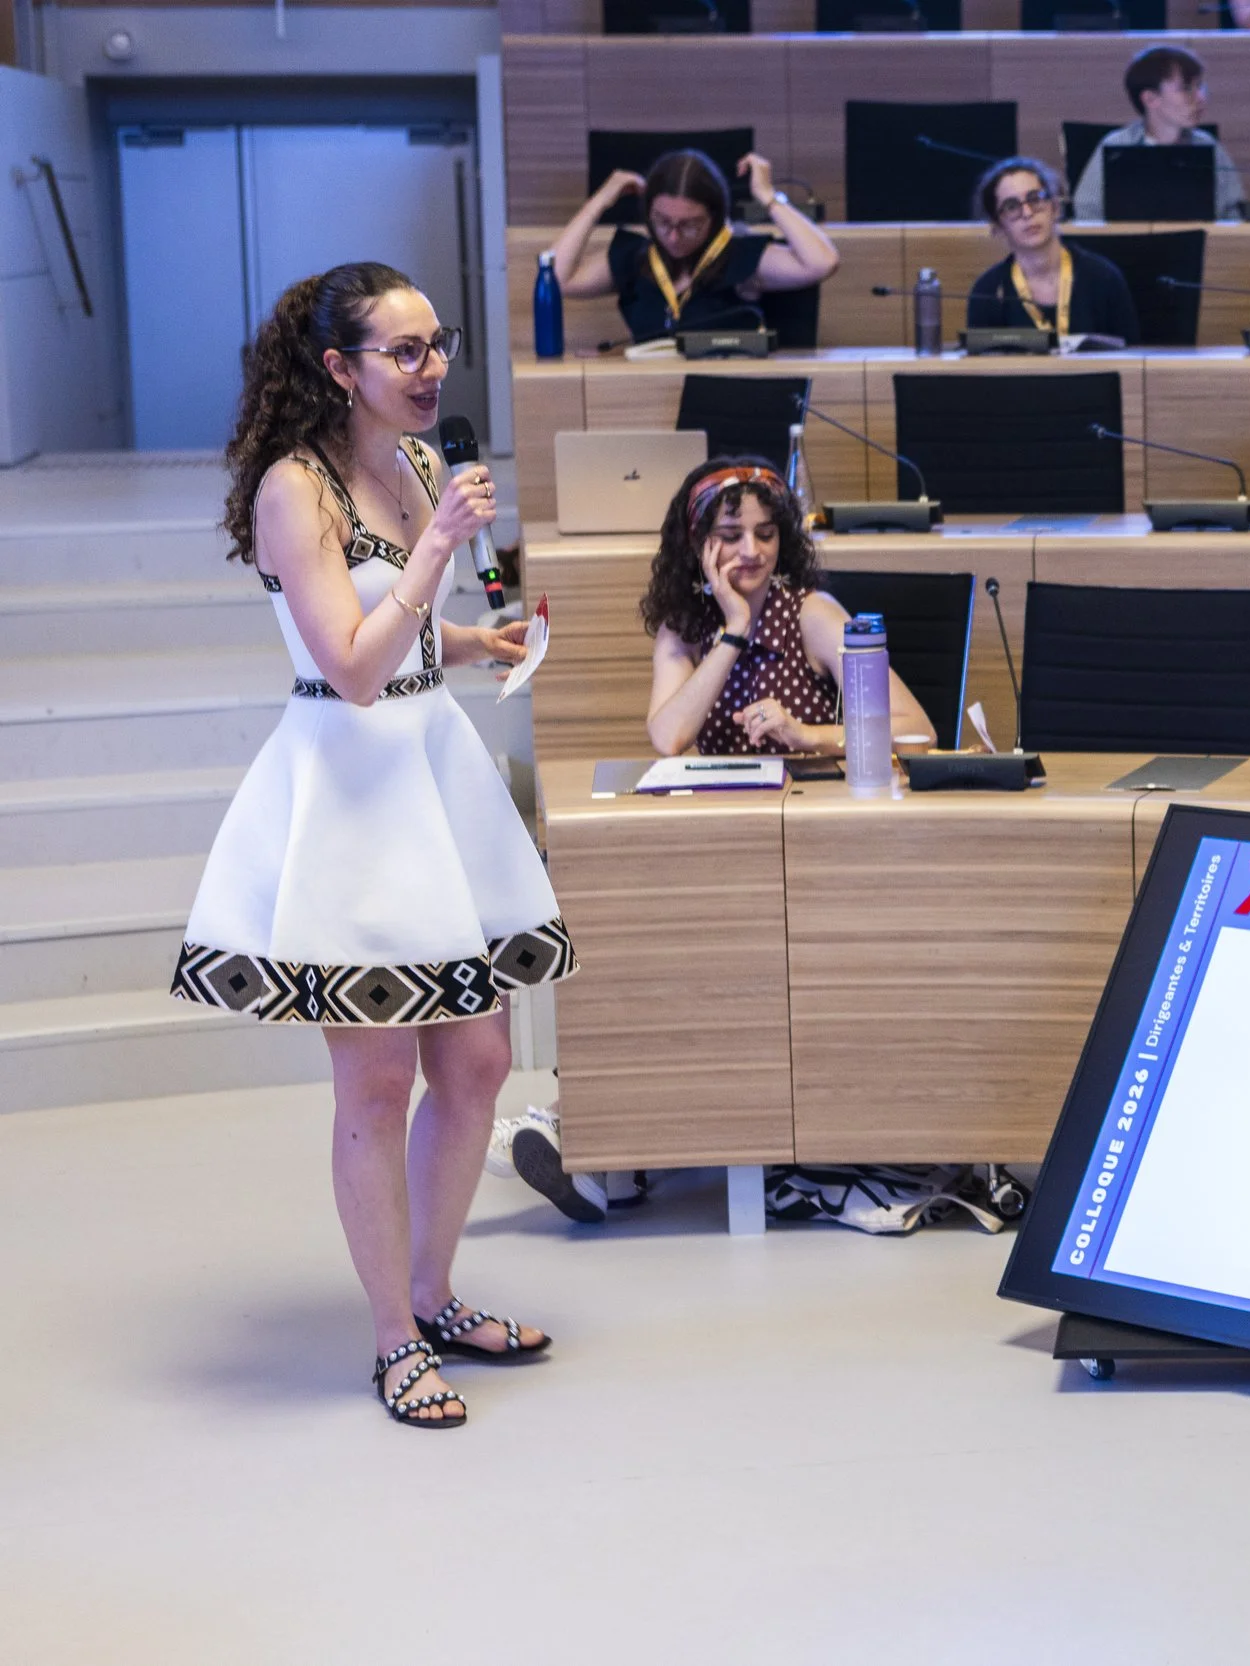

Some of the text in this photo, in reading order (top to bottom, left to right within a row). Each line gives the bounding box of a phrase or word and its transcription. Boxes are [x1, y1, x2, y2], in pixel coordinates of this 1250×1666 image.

[1184, 854, 1222, 936] Territoires
[1179, 939, 1193, 953] &
[1145, 955, 1187, 1047] Dirigeantes
[1117, 1068, 1149, 1132] 2026
[1069, 1139, 1125, 1266] COLLOQUE
